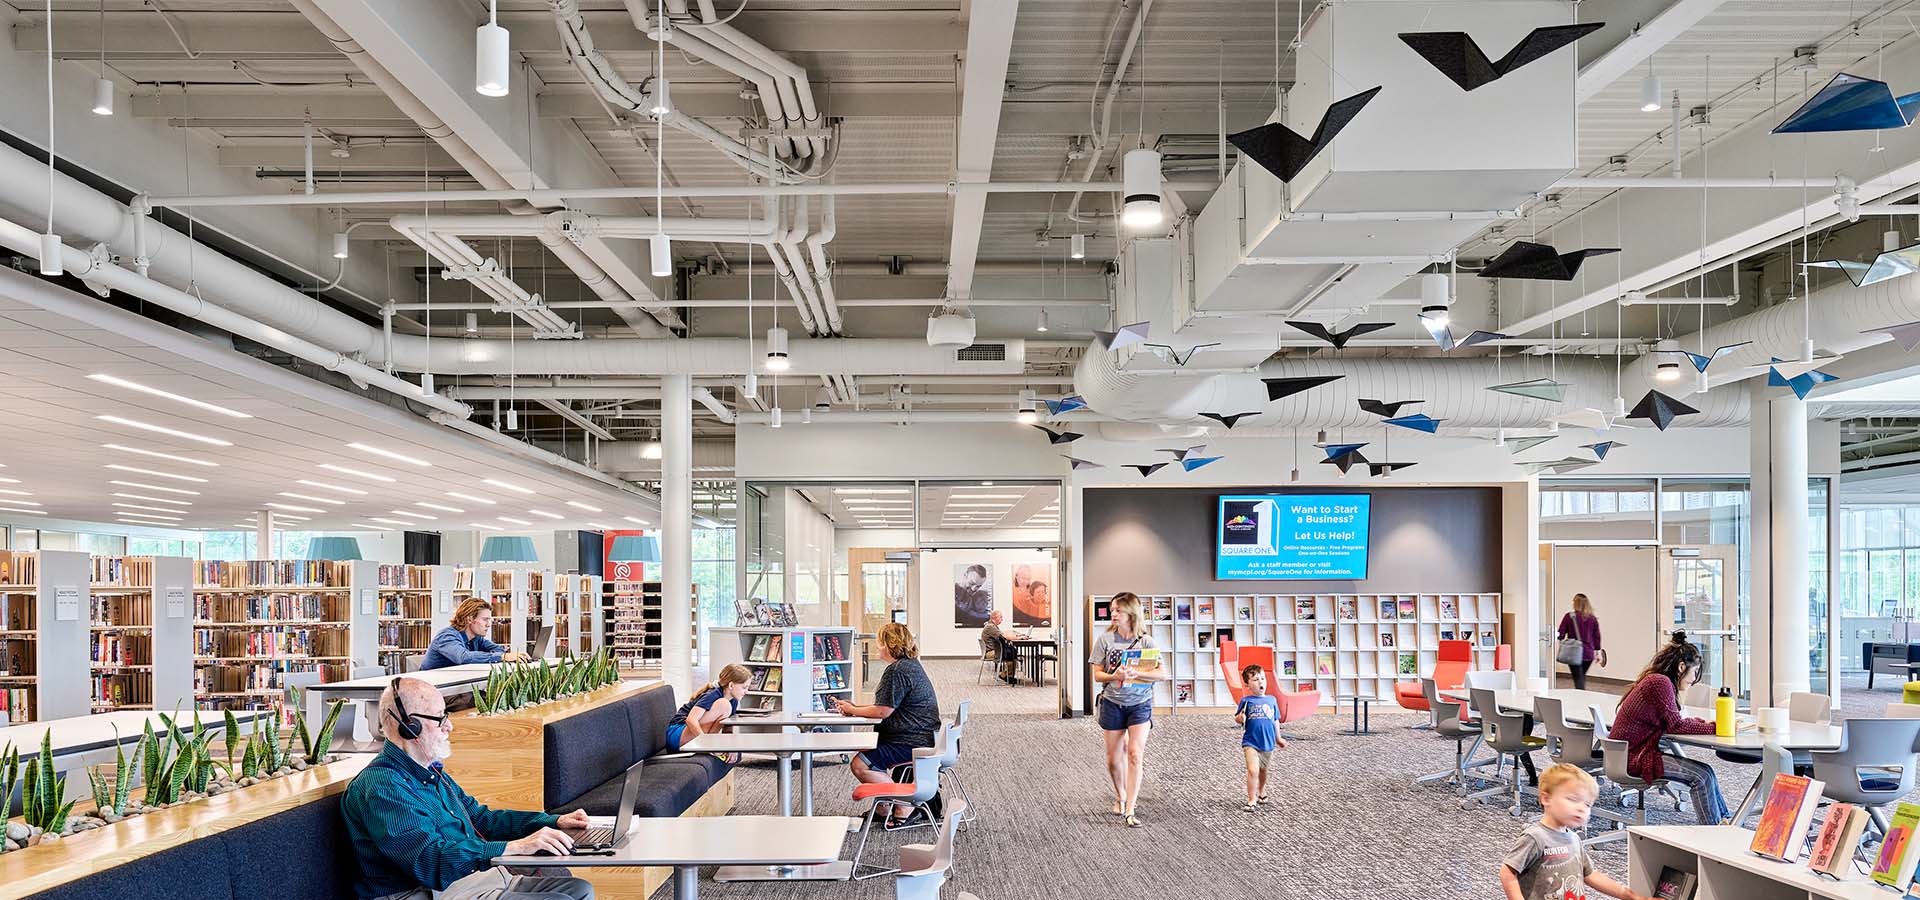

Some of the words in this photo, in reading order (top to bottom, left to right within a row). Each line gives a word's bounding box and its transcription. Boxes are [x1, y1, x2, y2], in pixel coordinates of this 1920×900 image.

[1291, 505, 1318, 514] Want
[1320, 506, 1331, 514] to
[1334, 505, 1358, 514] Start
[1306, 515, 1354, 523] Business?
[1295, 531, 1311, 540] Let
[1313, 531, 1326, 540] Us
[1328, 531, 1355, 541] Help!
[1222, 546, 1253, 555] SQUARE
[1254, 546, 1272, 554] ONE
[1544, 847, 1558, 856] RUN
[1557, 846, 1569, 855] FOR
